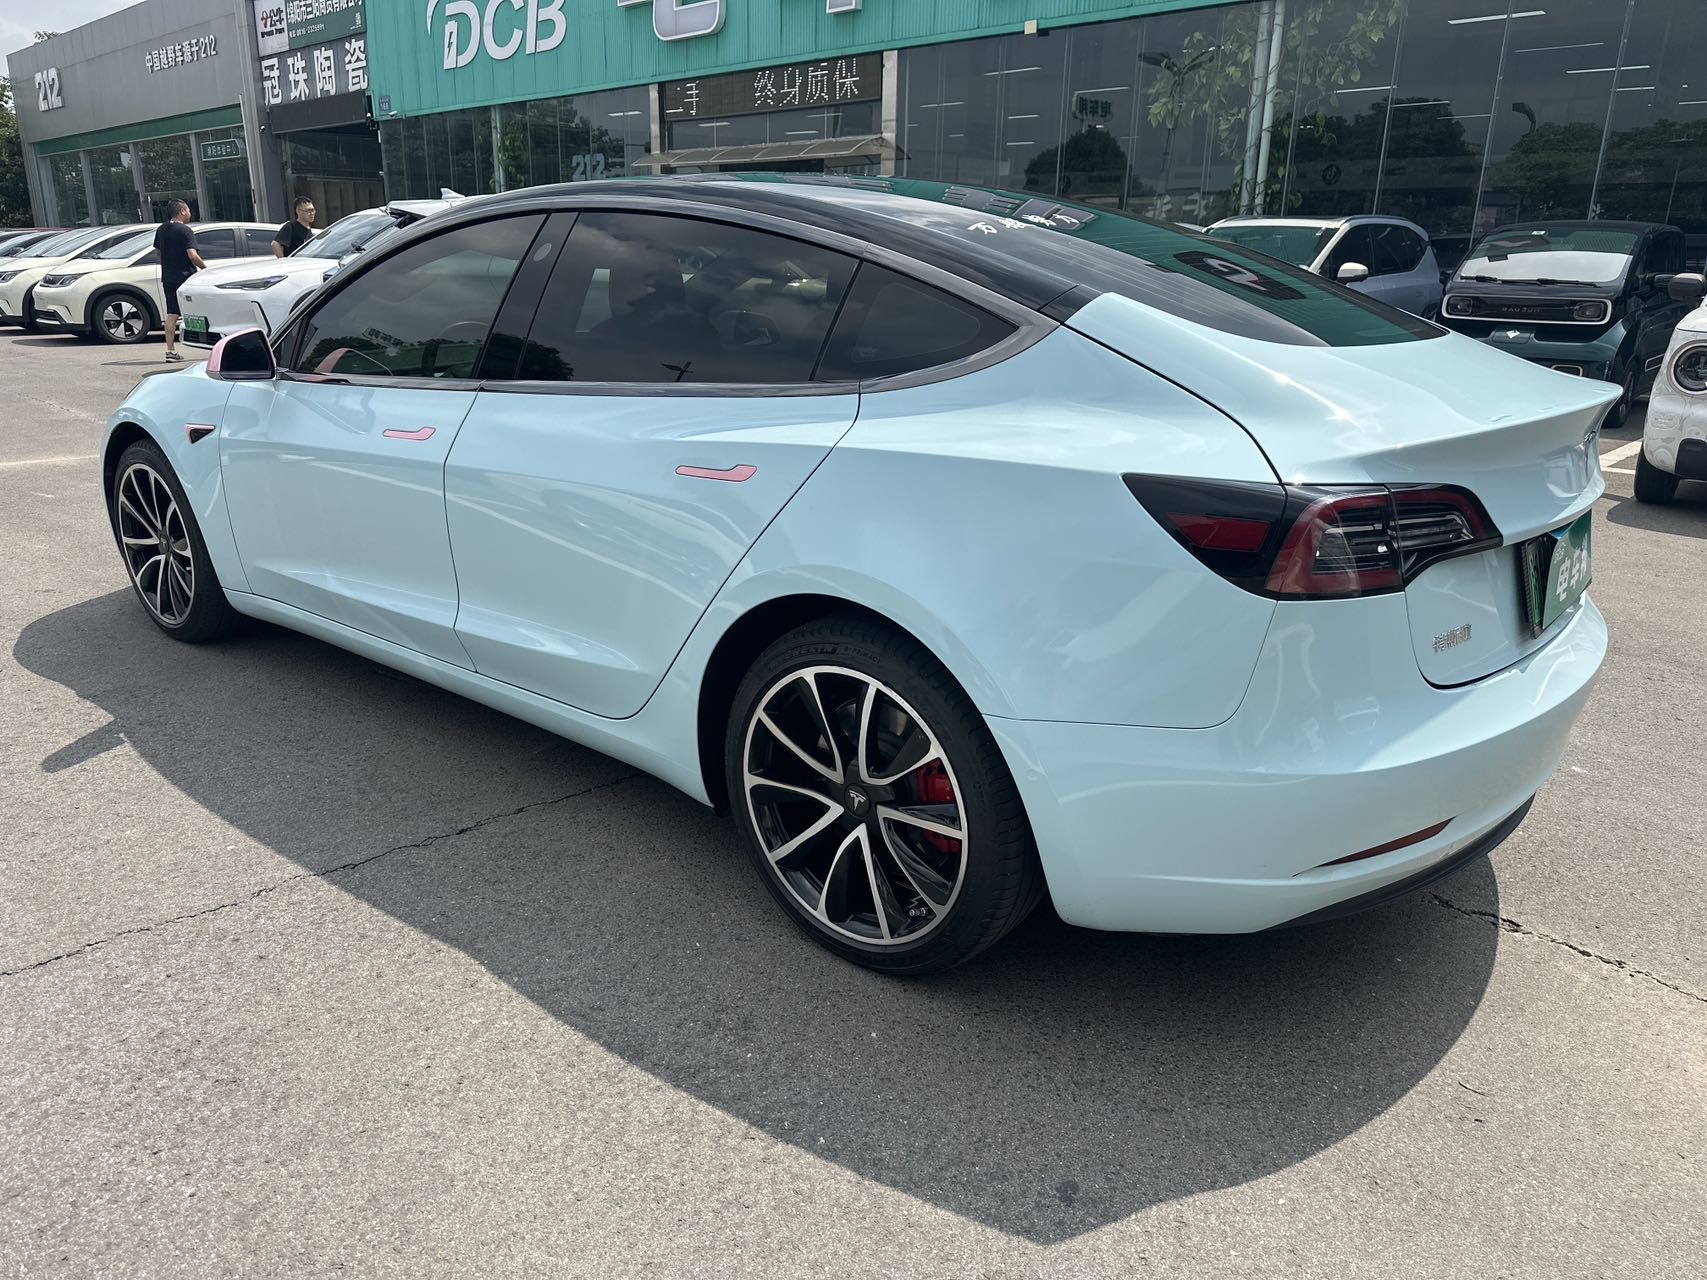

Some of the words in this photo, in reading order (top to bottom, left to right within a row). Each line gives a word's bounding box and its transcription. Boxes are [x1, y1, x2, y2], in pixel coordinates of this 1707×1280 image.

[443, 0, 567, 70] DCB
[34, 67, 65, 112] 212
[261, 39, 368, 106] 冠珠陶瓷
[754, 58, 860, 107] 终身质保
[572, 153, 606, 181] 212
